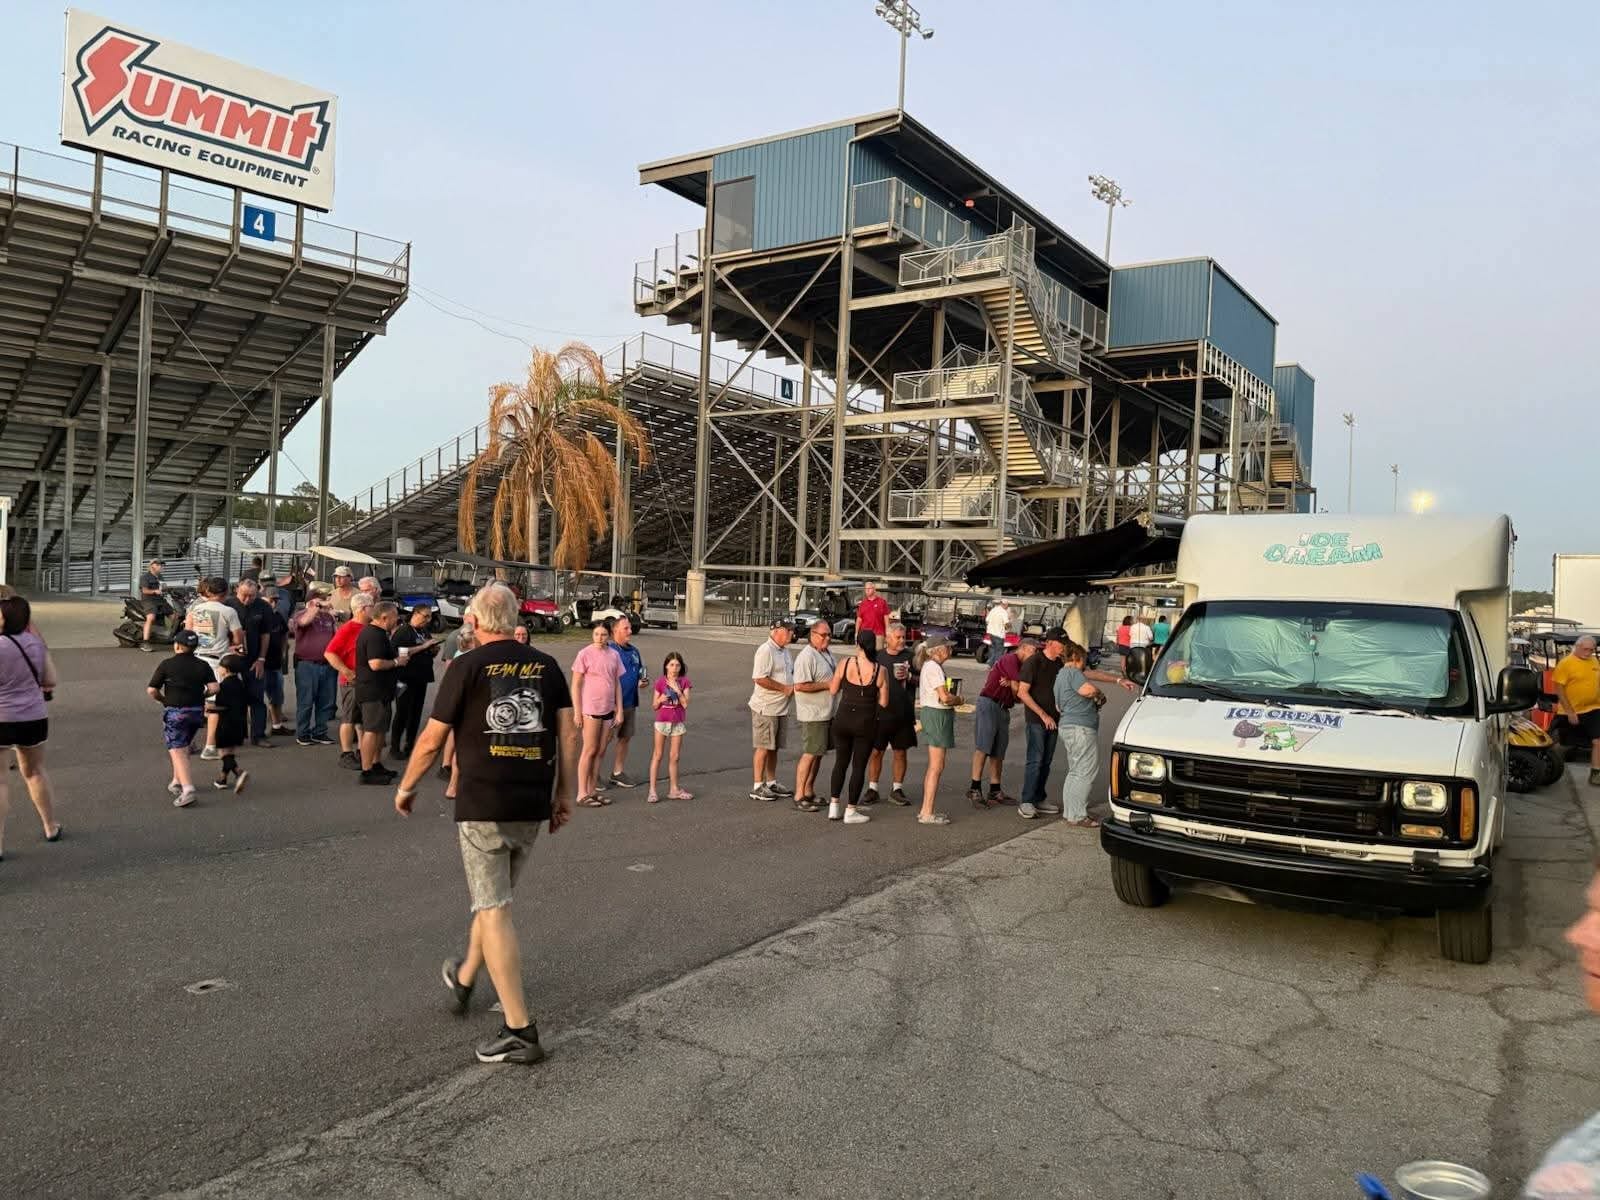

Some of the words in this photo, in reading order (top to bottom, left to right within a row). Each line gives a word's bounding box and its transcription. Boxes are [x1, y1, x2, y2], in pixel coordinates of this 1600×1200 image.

[112, 125, 191, 157] RACING
[197, 150, 308, 188] EQUIPMENT
[253, 214, 265, 235] 4
[1264, 543, 1383, 565] CREAM
[485, 662, 518, 677] TEAM
[1226, 707, 1261, 720] ICE
[1266, 709, 1343, 728] CREAM
